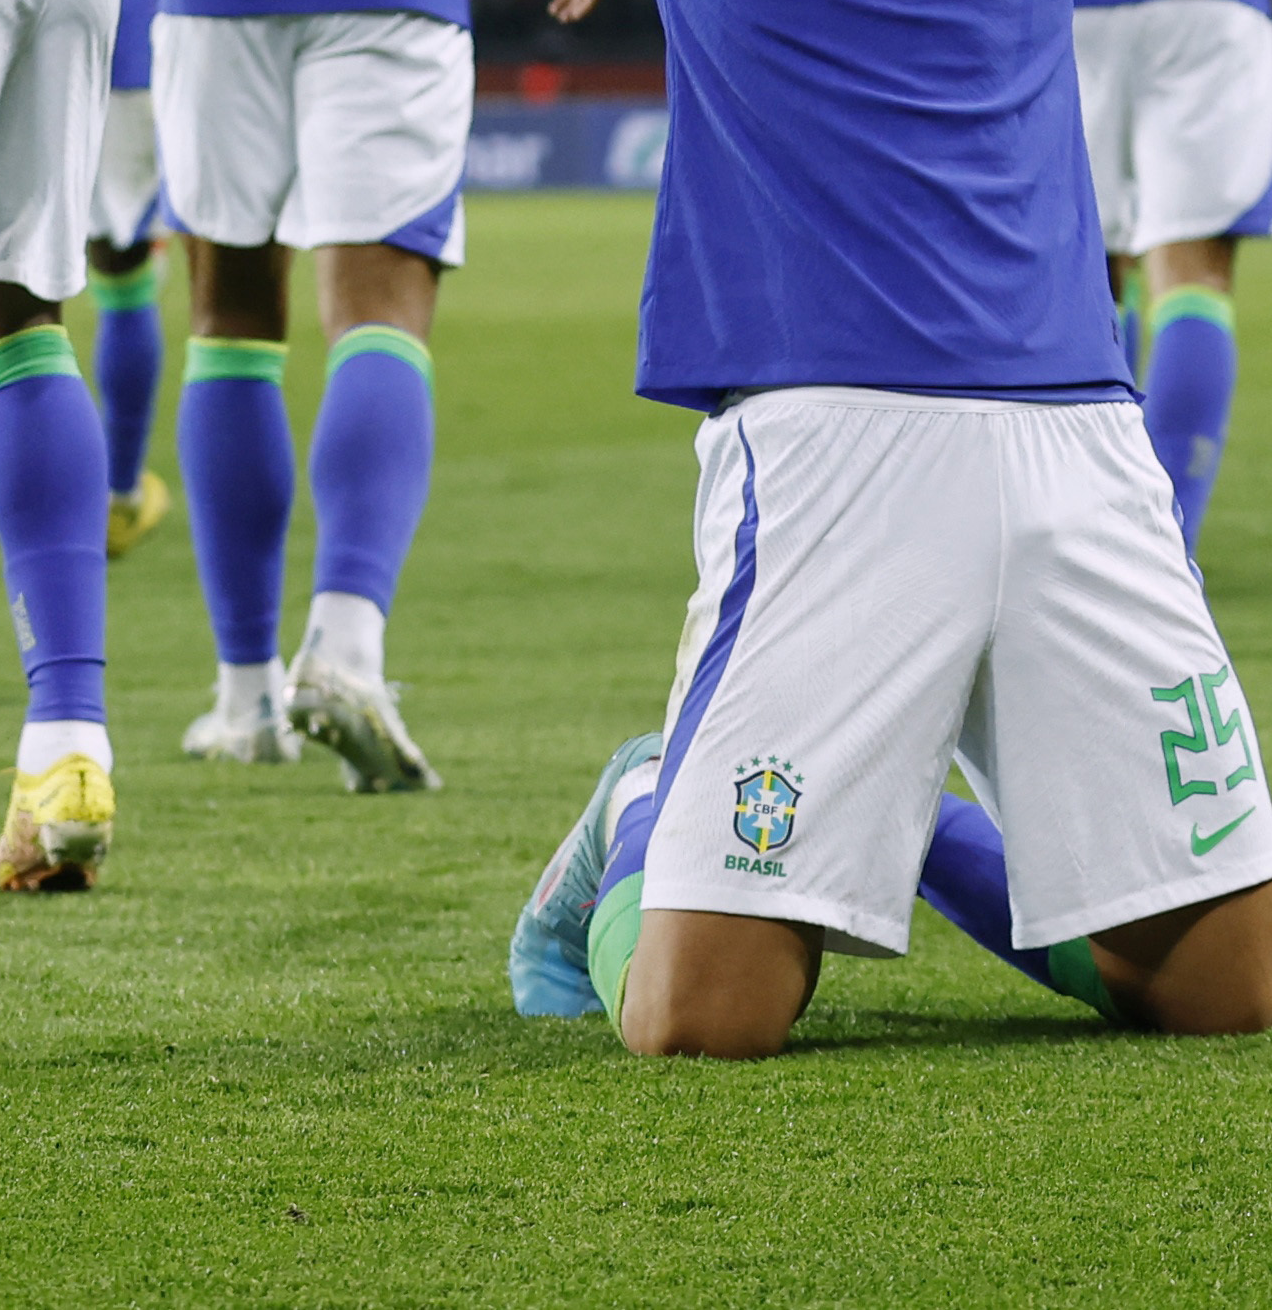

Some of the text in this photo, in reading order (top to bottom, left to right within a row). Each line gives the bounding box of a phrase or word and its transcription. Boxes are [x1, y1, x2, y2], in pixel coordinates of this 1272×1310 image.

[1150, 664, 1257, 807] 25
[753, 803, 778, 815] CBF
[724, 854, 787, 877] BRASIL
